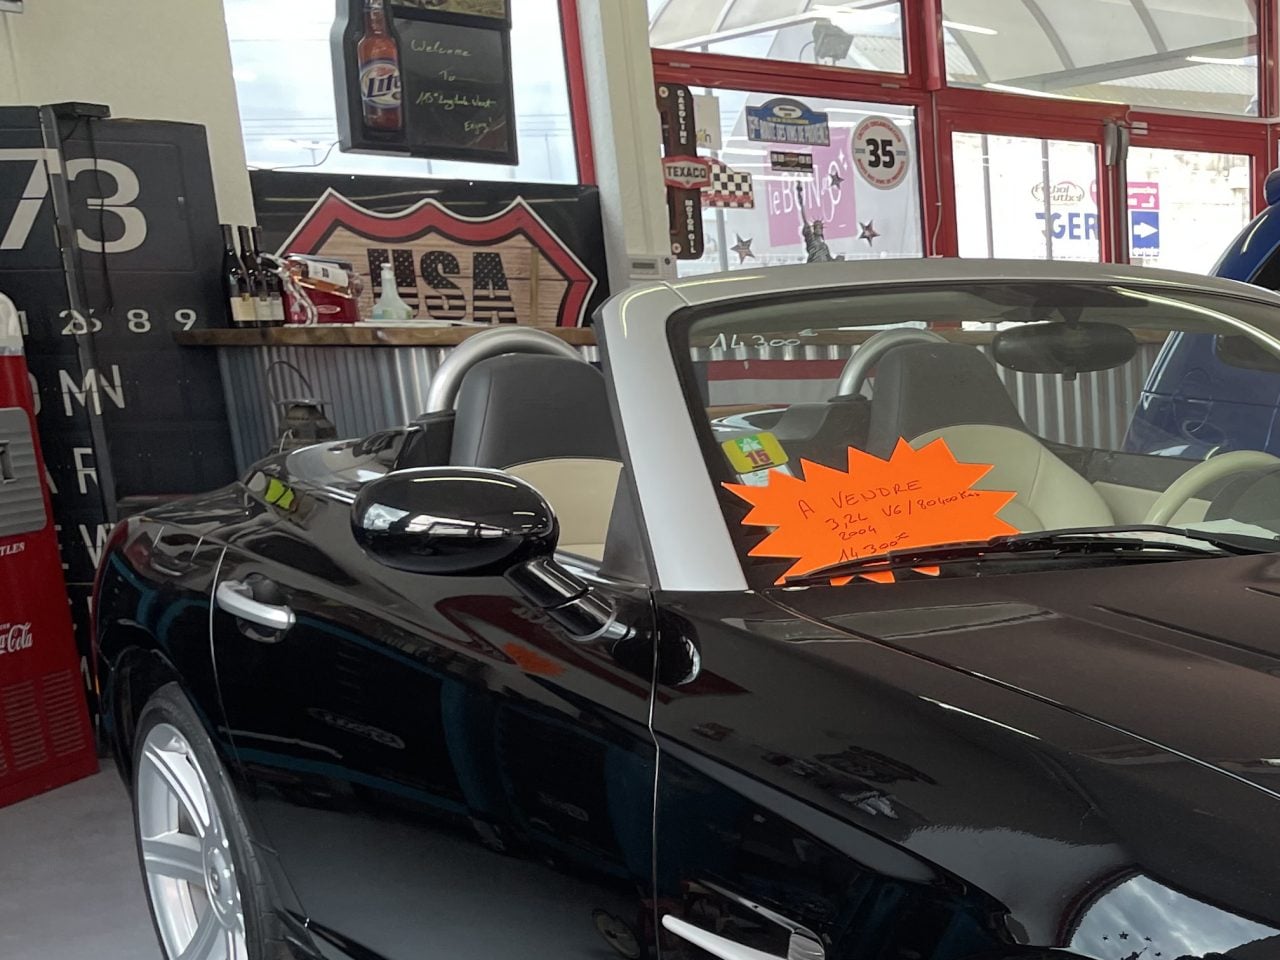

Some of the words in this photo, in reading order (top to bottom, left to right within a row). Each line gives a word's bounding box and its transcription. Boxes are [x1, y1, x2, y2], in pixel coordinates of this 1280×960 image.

[411, 39, 472, 57] Welcome
[676, 89, 687, 145] GASOLINE
[865, 137, 895, 169] 35
[666, 165, 707, 179] TEXACO
[685, 199, 695, 231] MOTOR
[688, 233, 696, 254] OIL
[367, 248, 518, 325] USA
[745, 449, 772, 466] 15
[797, 500, 815, 519] A
[831, 479, 922, 509] VENDRE
[838, 525, 876, 541] 2004
